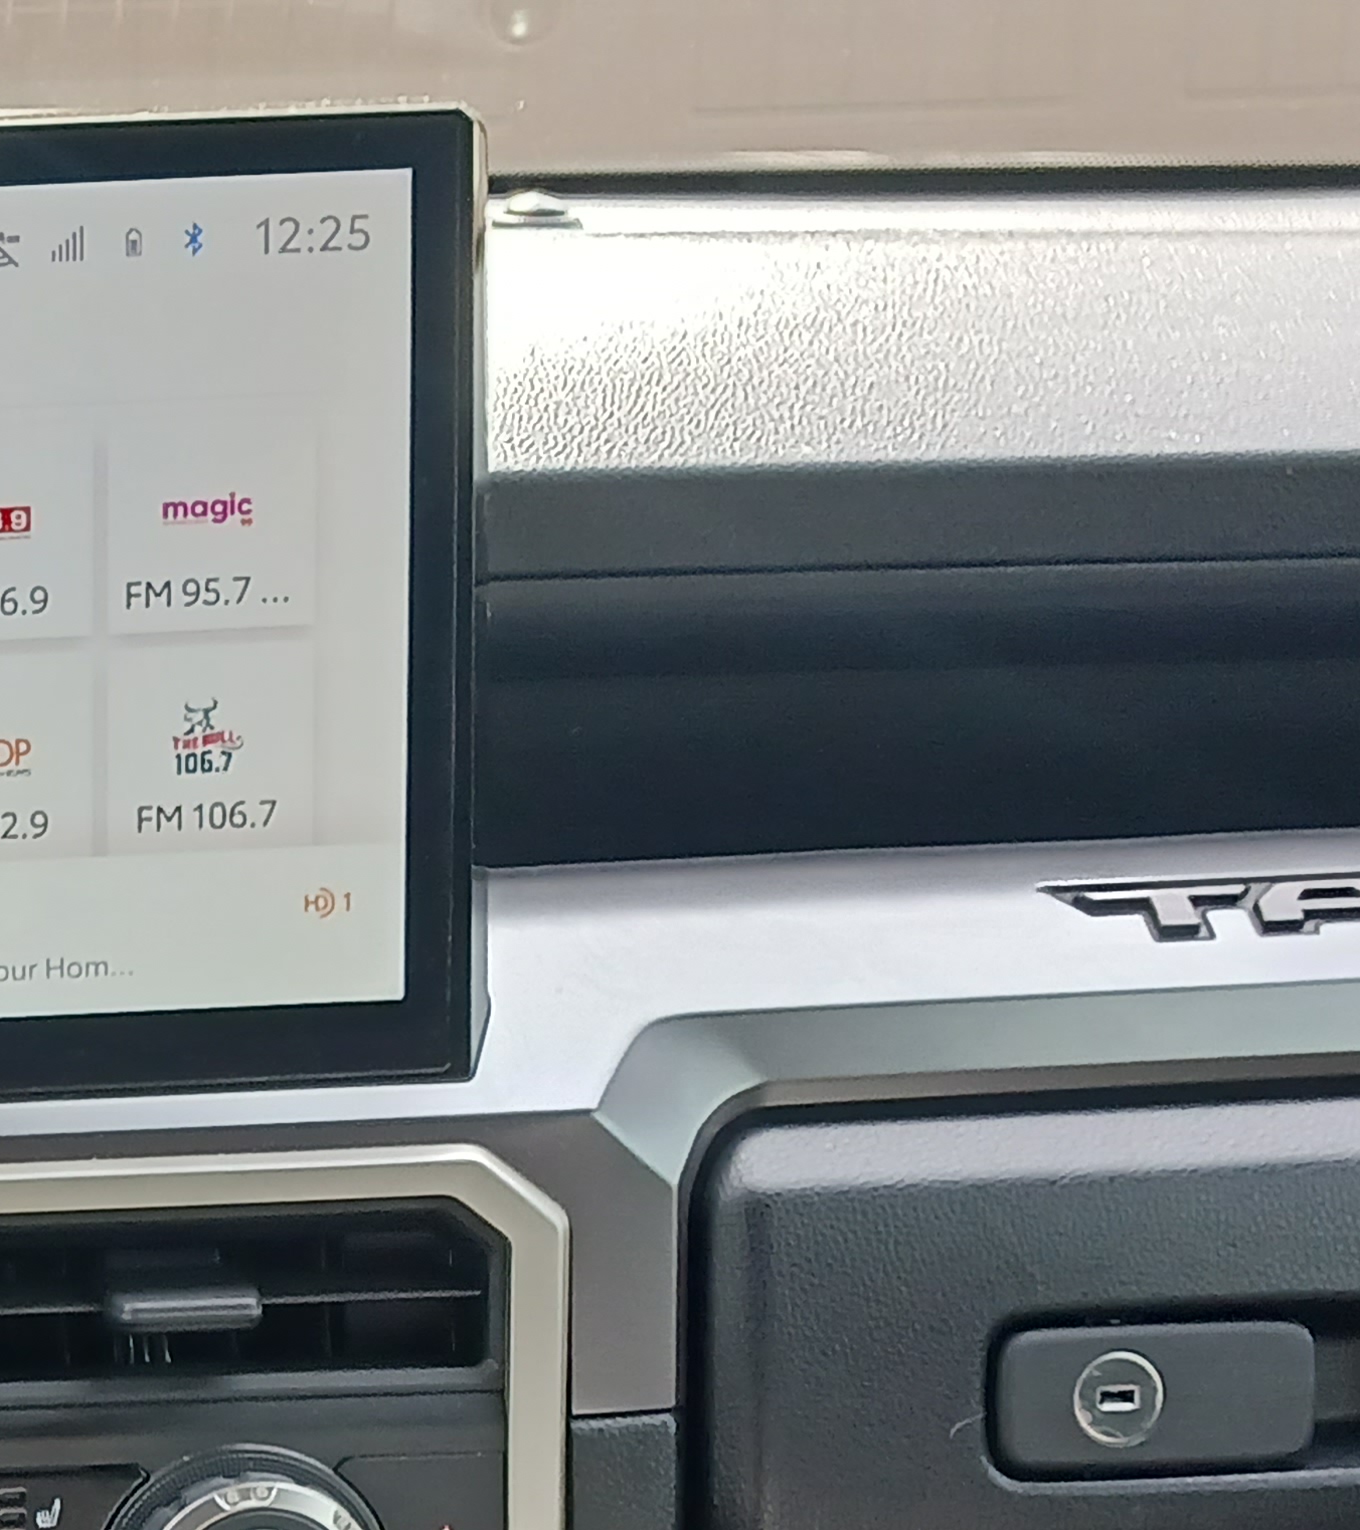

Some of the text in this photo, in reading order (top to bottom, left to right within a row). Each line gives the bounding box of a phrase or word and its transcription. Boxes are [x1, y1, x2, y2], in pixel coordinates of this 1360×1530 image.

[255, 213, 371, 256] 12:25
[162, 492, 253, 524] magic
[125, 579, 172, 610] FM
[181, 576, 252, 608] 95.7
[175, 749, 233, 776] 106.7
[137, 799, 277, 834] FM 106.7
